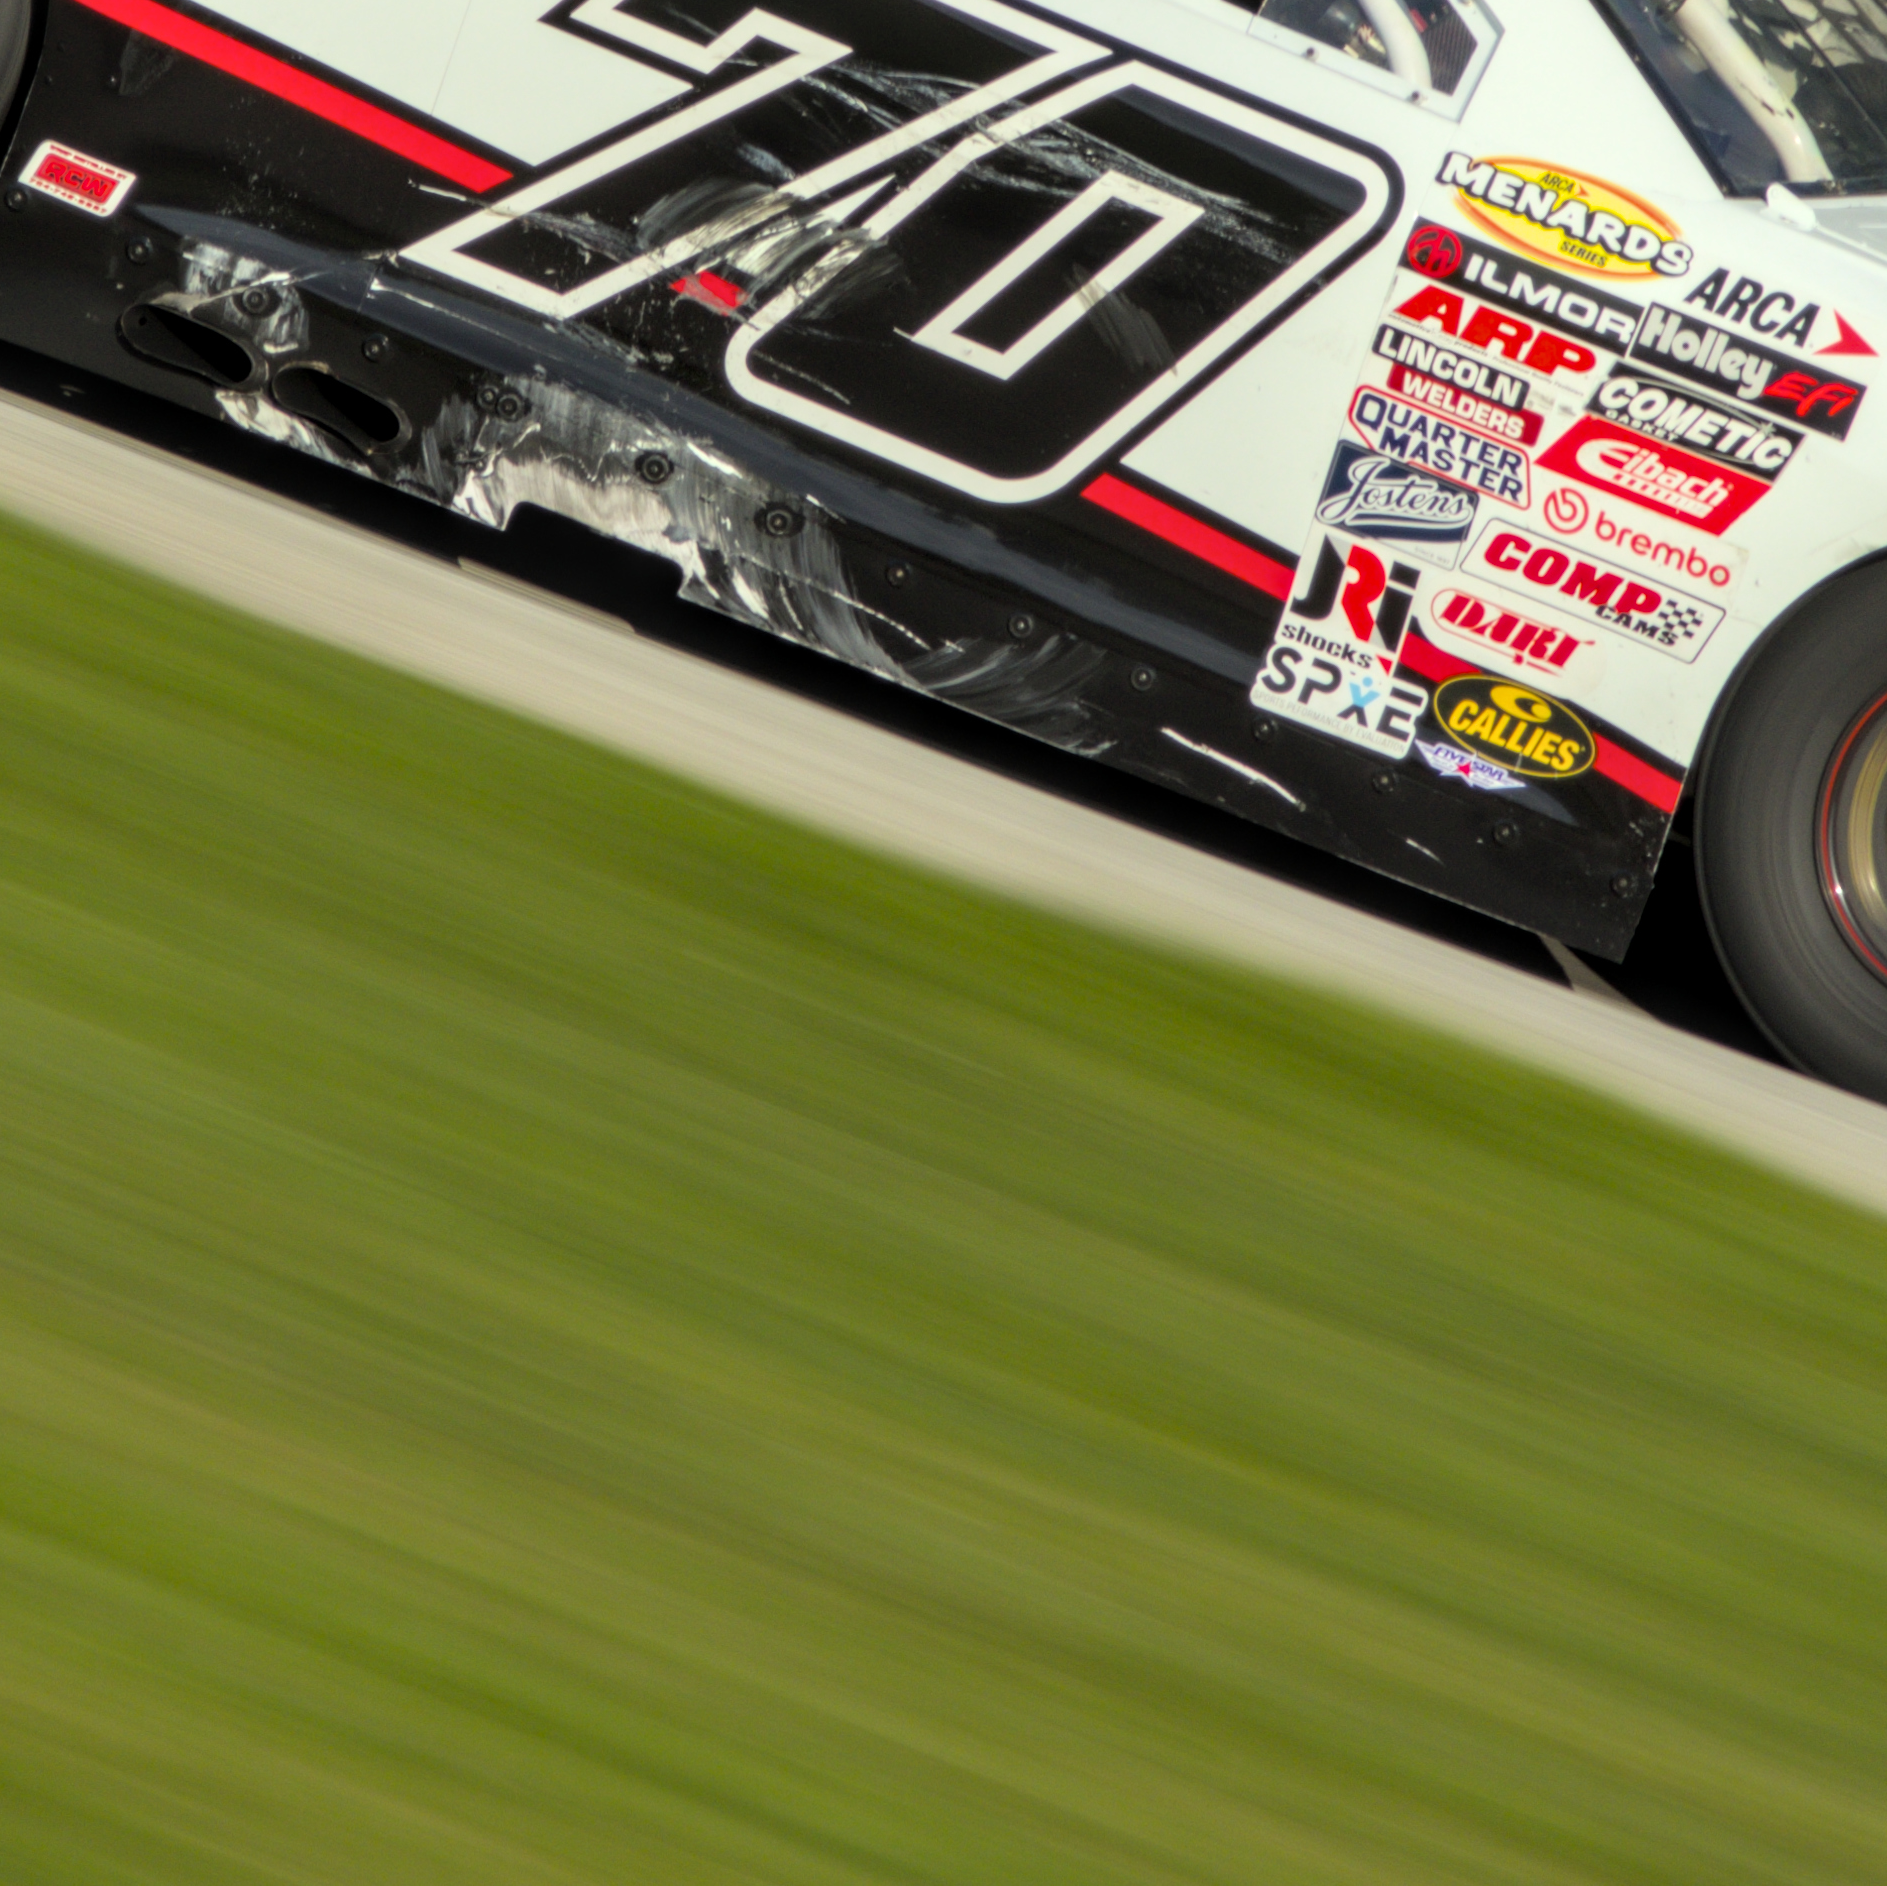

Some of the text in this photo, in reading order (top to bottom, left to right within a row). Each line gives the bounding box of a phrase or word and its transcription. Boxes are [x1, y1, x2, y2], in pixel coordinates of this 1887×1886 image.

[45, 162, 107, 196] RCW
[1435, 151, 1693, 277] MENARDS
[1539, 171, 1575, 194] ARCA
[1560, 240, 1608, 268] SERIES
[1393, 284, 1596, 376] ARP
[1464, 252, 1636, 344] ILMOR
[1684, 266, 1821, 348] ARCA
[1378, 327, 1523, 409] LINCOLN
[1638, 306, 1774, 401] Holley
[1355, 393, 1523, 477] QUARTER
[1401, 371, 1525, 440] WELDERS
[1599, 376, 1792, 469] COMETIC
[1605, 409, 1678, 442] GASKET
[1316, 457, 1470, 526] Jostens
[1379, 426, 1524, 503] MASTER
[1576, 438, 1730, 508] Eibach
[1484, 532, 1662, 615] COMP
[1595, 510, 1730, 587] brembo
[1282, 624, 1373, 669] shocks
[1442, 593, 1596, 670] DART
[1595, 604, 1679, 647] CAMS
[1253, 688, 1286, 711] SPORTS
[1355, 726, 1407, 754] EVALUATION
[1448, 699, 1581, 772] CALLIES
